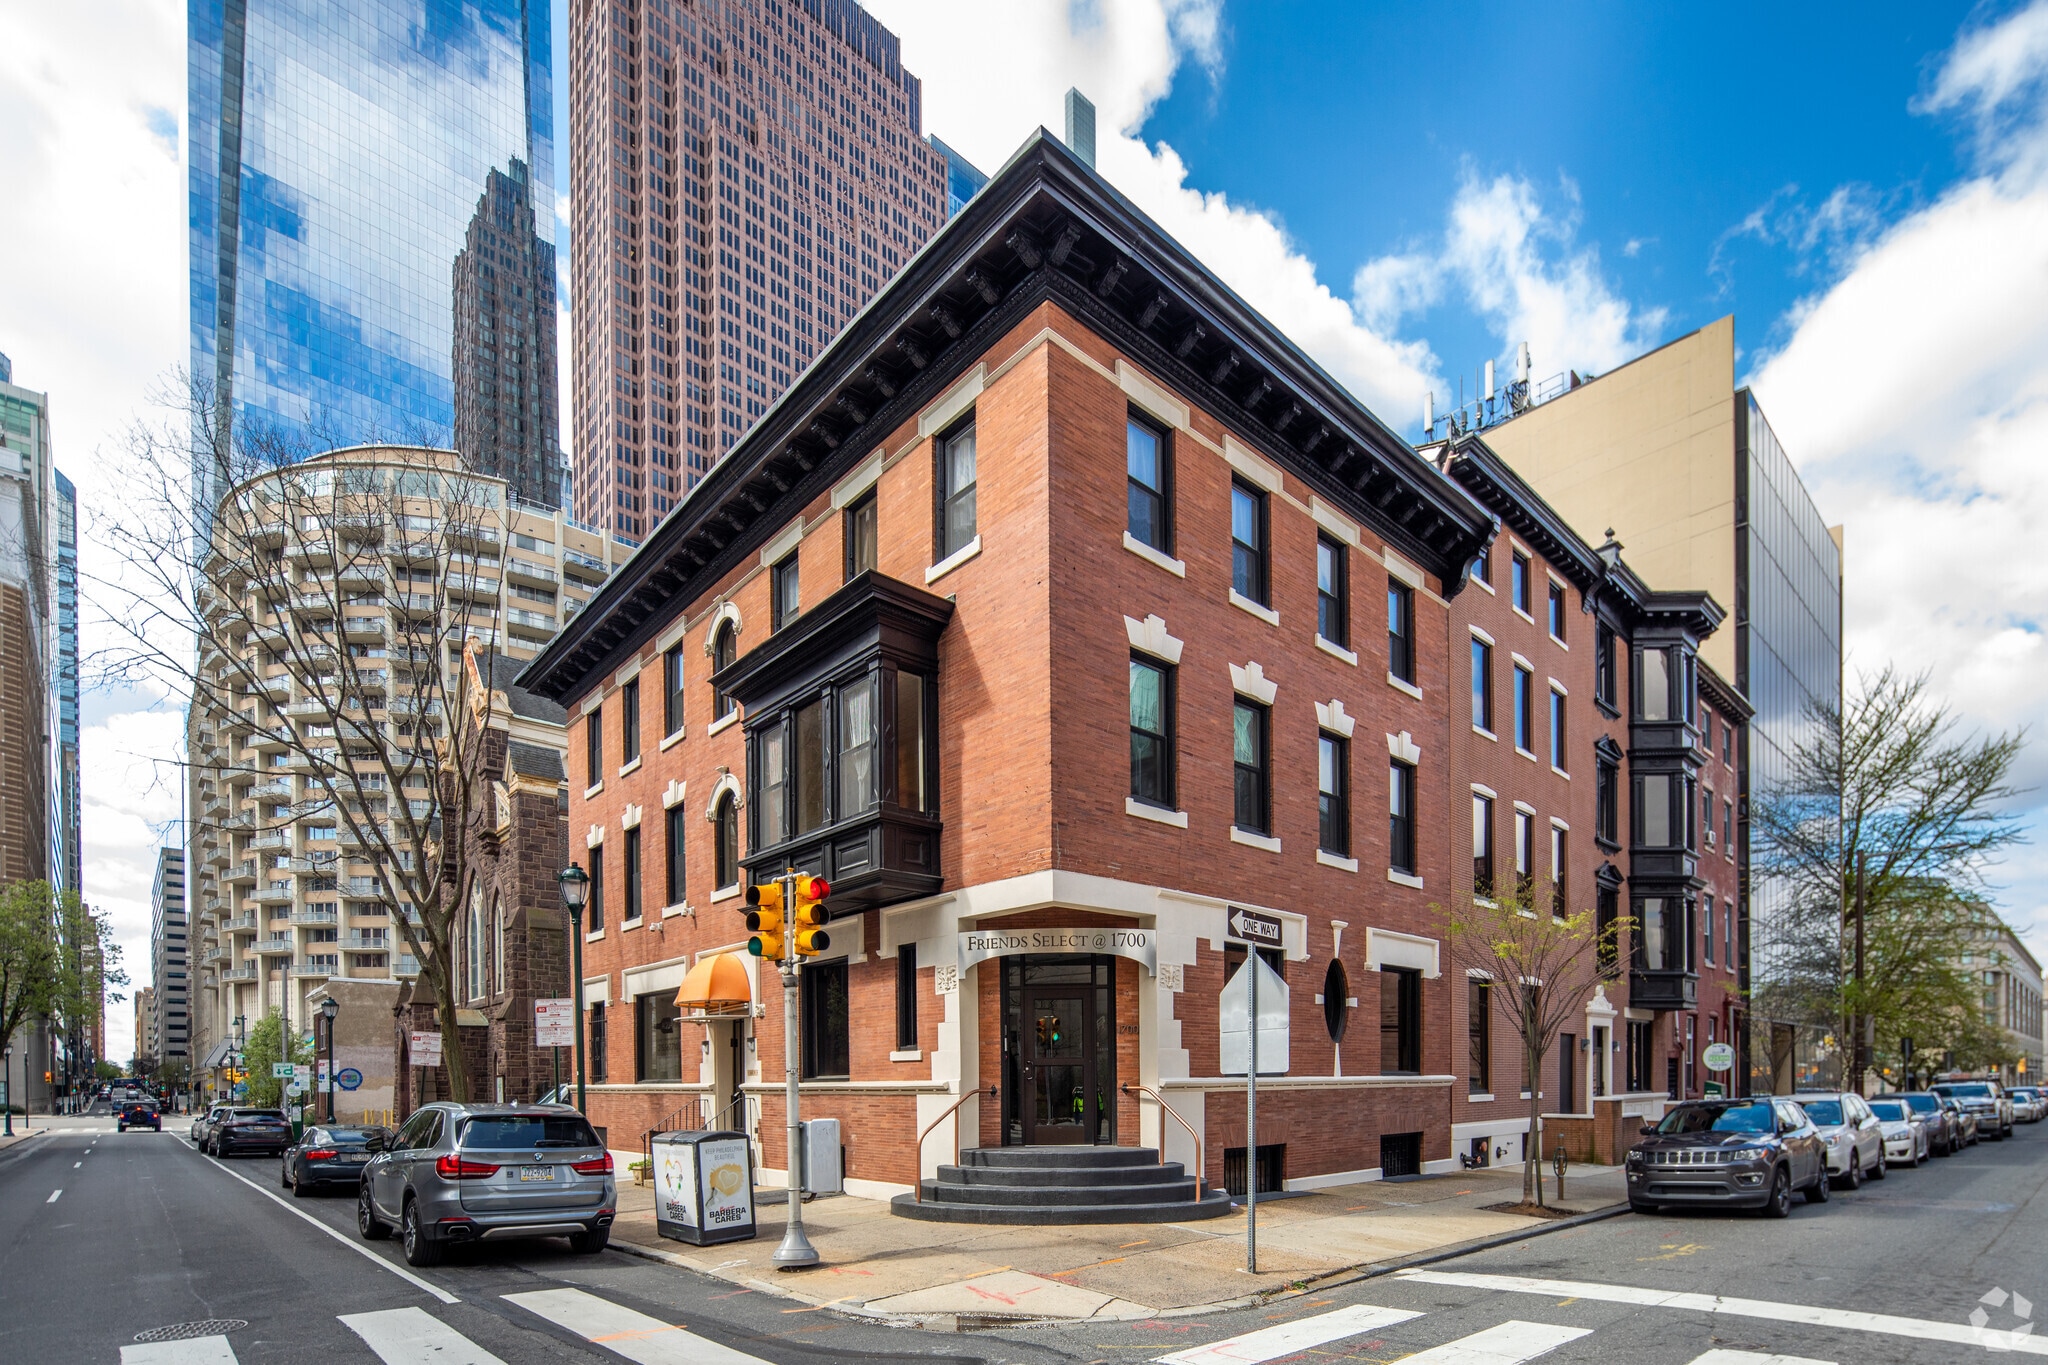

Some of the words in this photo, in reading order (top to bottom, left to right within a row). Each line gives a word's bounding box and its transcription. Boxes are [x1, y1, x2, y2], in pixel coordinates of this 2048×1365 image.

[1243, 919, 1258, 934] ONE
[1260, 923, 1276, 937] WAY
[967, 935, 1028, 951] FRIENDS
[1032, 932, 1089, 948] SELECT
[1091, 933, 1107, 950] @
[1111, 932, 1147, 948] 1700
[666, 1202, 687, 1214] BARBERA
[709, 1207, 746, 1218] BARBERA
[669, 1210, 685, 1222] CARES
[715, 1214, 741, 1224] CARES
